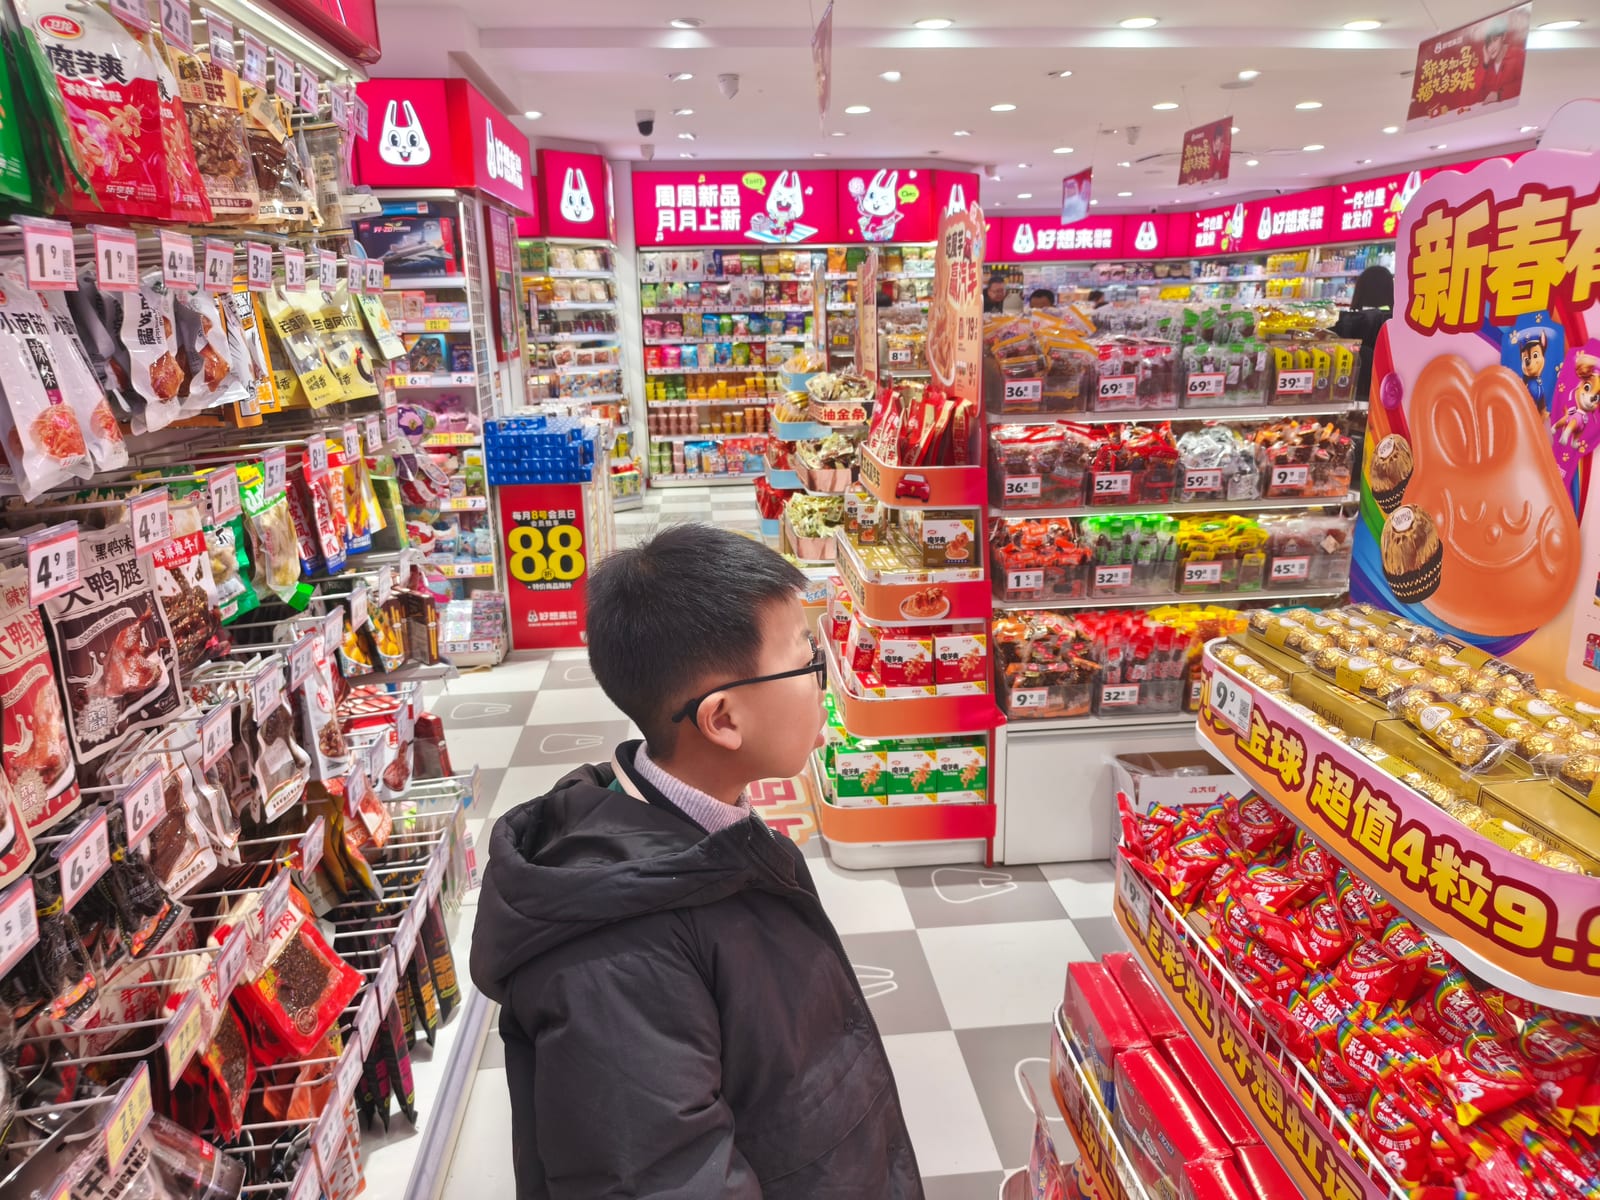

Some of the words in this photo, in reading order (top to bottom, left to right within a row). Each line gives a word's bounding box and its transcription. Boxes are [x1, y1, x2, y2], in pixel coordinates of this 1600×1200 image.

[45, 44, 128, 84] 魔芋爽
[655, 184, 740, 208] 周周新品
[1344, 187, 1386, 209] 一件也是
[656, 209, 741, 232] 月月上新
[1272, 209, 1310, 235] 好想来
[1341, 210, 1373, 230] 批发价
[1037, 228, 1093, 249] 好想来
[512, 509, 576, 521] 每月8号会员日
[508, 524, 587, 582] 88
[1311, 701, 1344, 731] ROCHER
[1310, 760, 1600, 969] 超值4粒9.
[1292, 1001, 1320, 1030] 彩虹
[1311, 991, 1341, 1025] 彩虹
[1346, 1036, 1383, 1075] 彩虹
